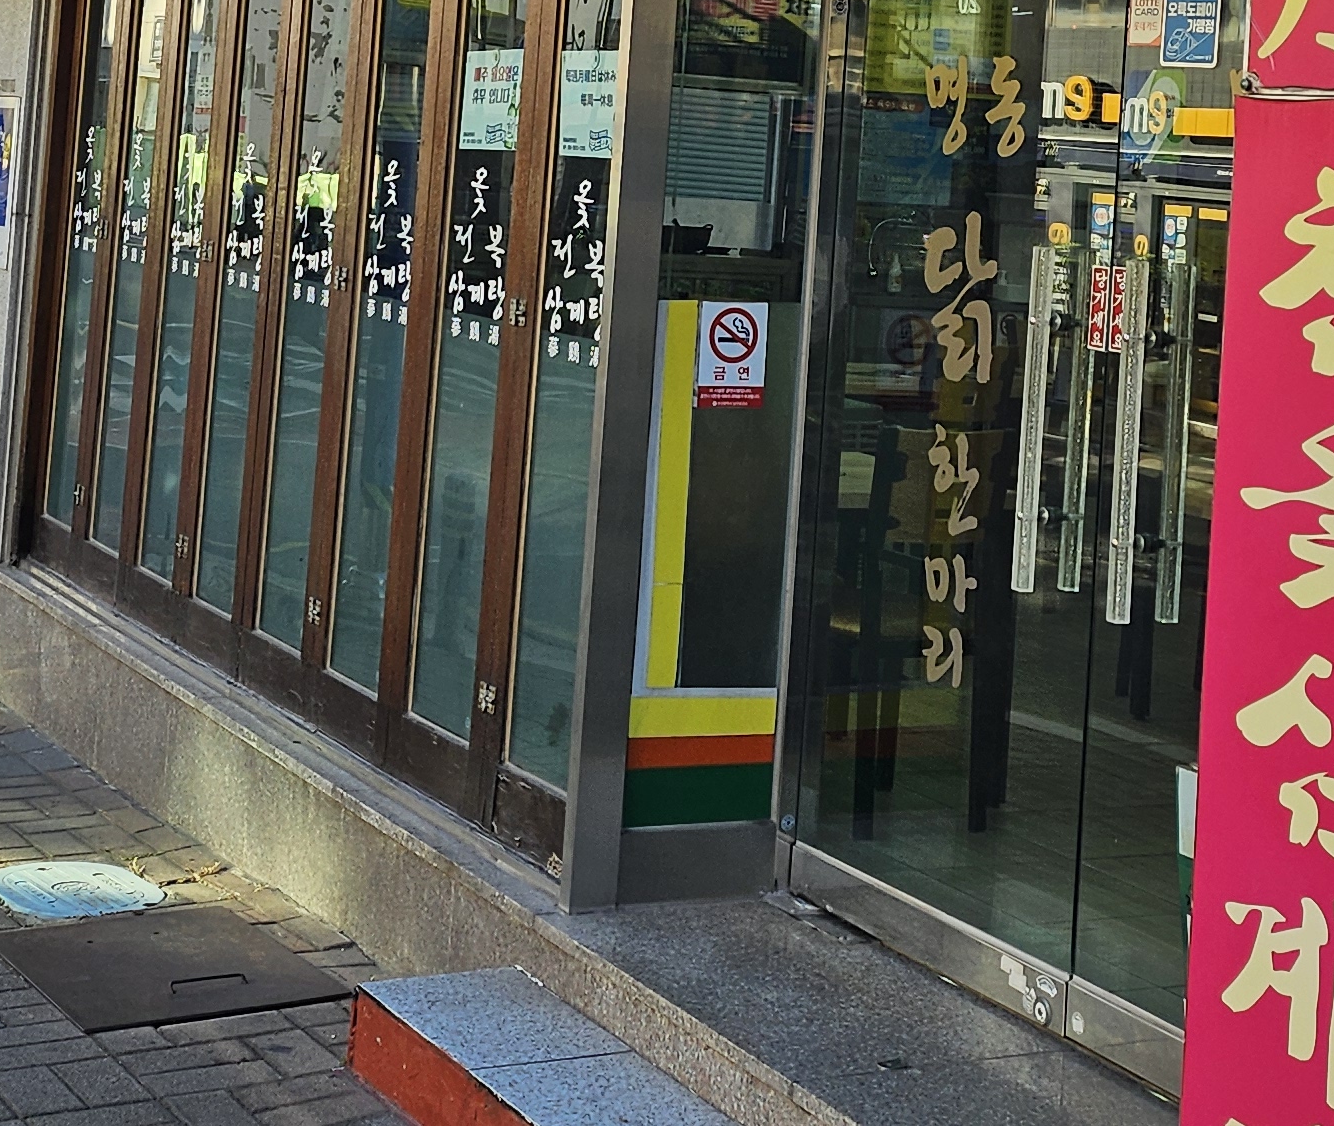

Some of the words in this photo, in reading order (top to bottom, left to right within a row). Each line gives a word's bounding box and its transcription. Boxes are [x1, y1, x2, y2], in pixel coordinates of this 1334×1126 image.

[1134, 8, 1159, 16] CARD
[1135, 0, 1159, 7] LOTTE
[924, 55, 1027, 158] 명동
[448, 270, 505, 321] 삼계탕
[923, 211, 998, 384] 닭
[1090, 271, 1108, 348] 당기세요
[923, 423, 980, 689] 한마리
